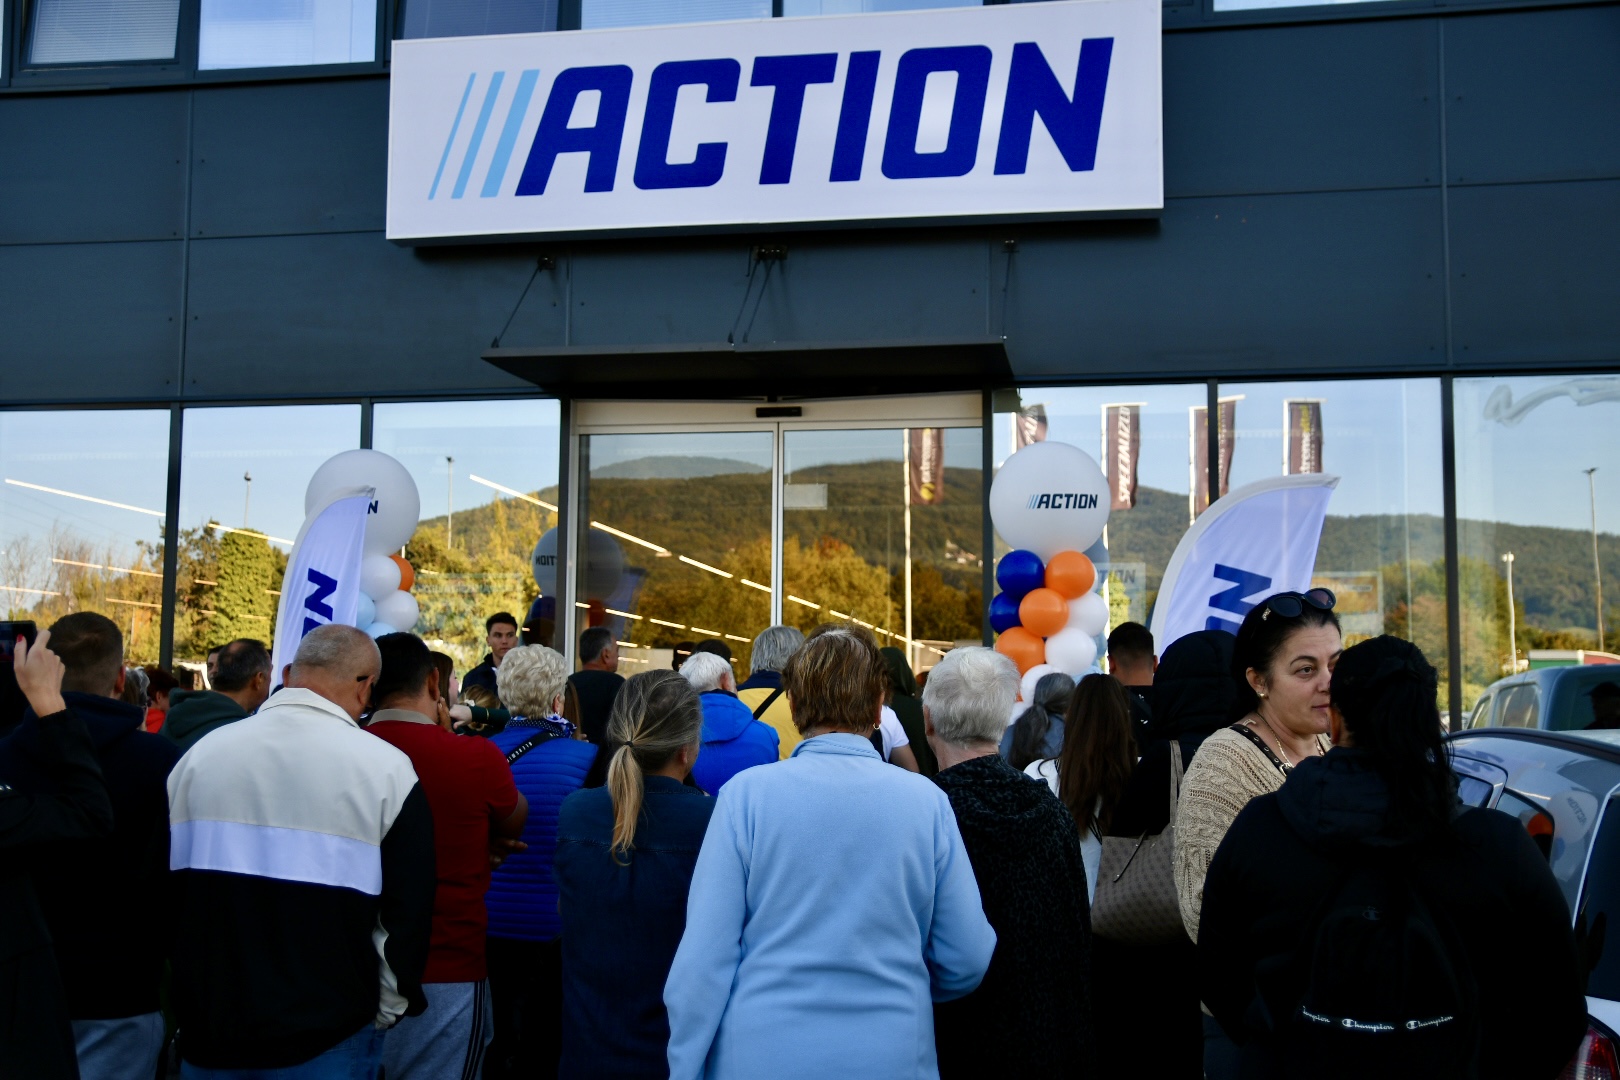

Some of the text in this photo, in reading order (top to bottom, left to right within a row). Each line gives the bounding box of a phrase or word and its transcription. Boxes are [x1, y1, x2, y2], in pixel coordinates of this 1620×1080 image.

[514, 36, 1115, 197] ACTION
[1037, 493, 1098, 510] ACTION
[1341, 1018, 1395, 1033] Champion
[1406, 1015, 1454, 1030] Champion
